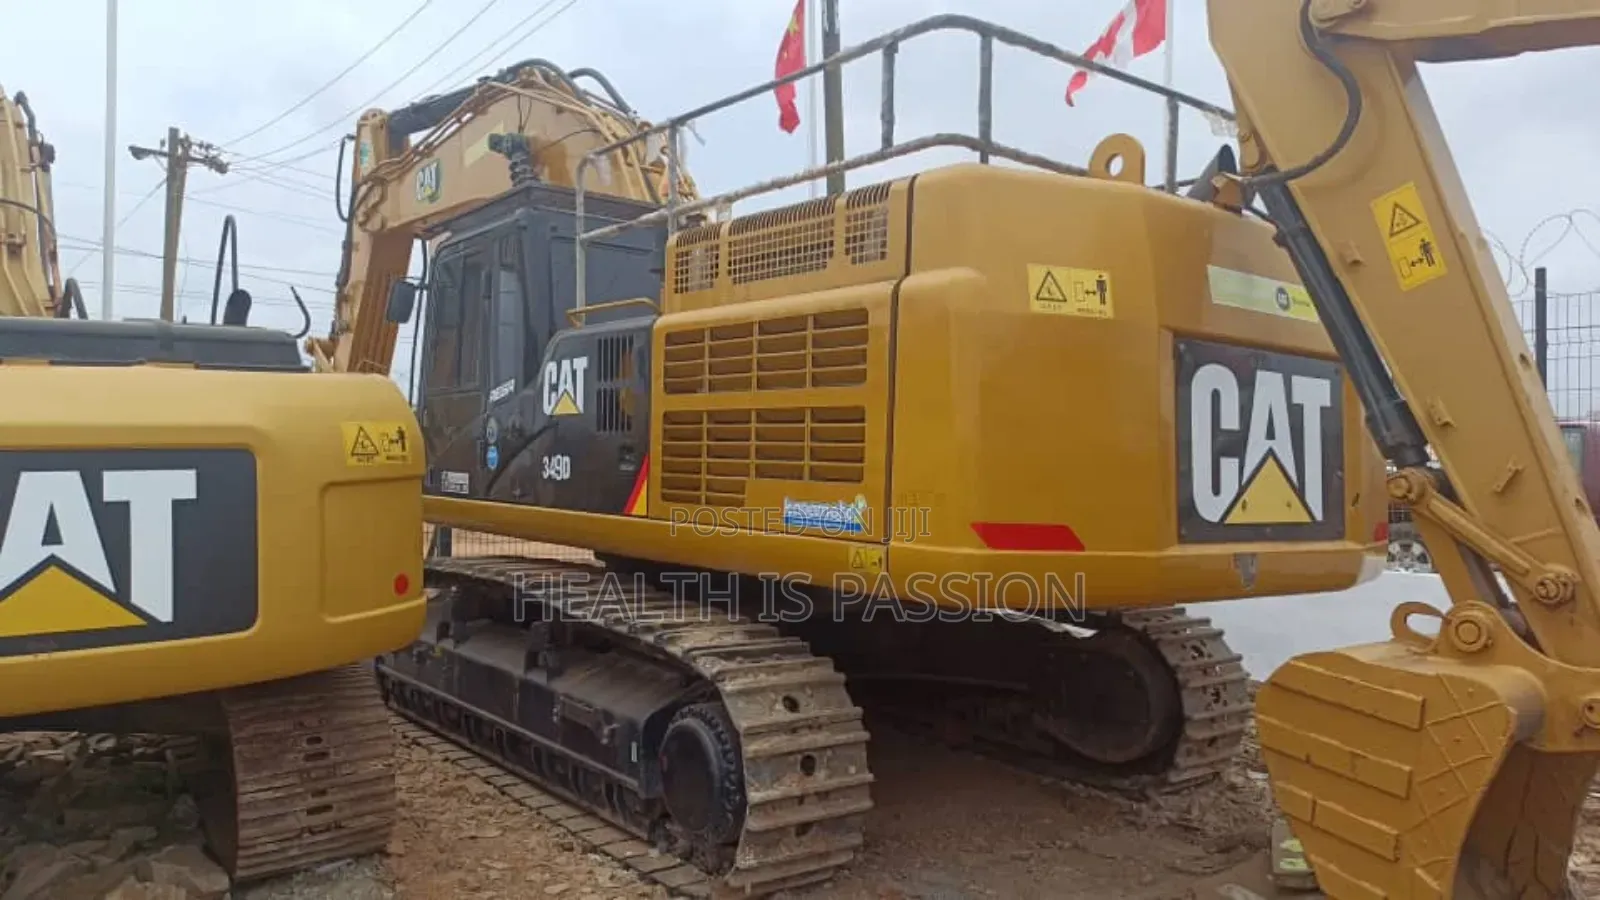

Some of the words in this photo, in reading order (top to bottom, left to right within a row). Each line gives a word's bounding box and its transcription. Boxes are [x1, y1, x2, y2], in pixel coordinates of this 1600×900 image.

[415, 162, 438, 201] CAT
[543, 356, 588, 416] CAT
[541, 454, 571, 481] 349D
[1191, 363, 1331, 523] CAT
[0, 469, 197, 623] AT
